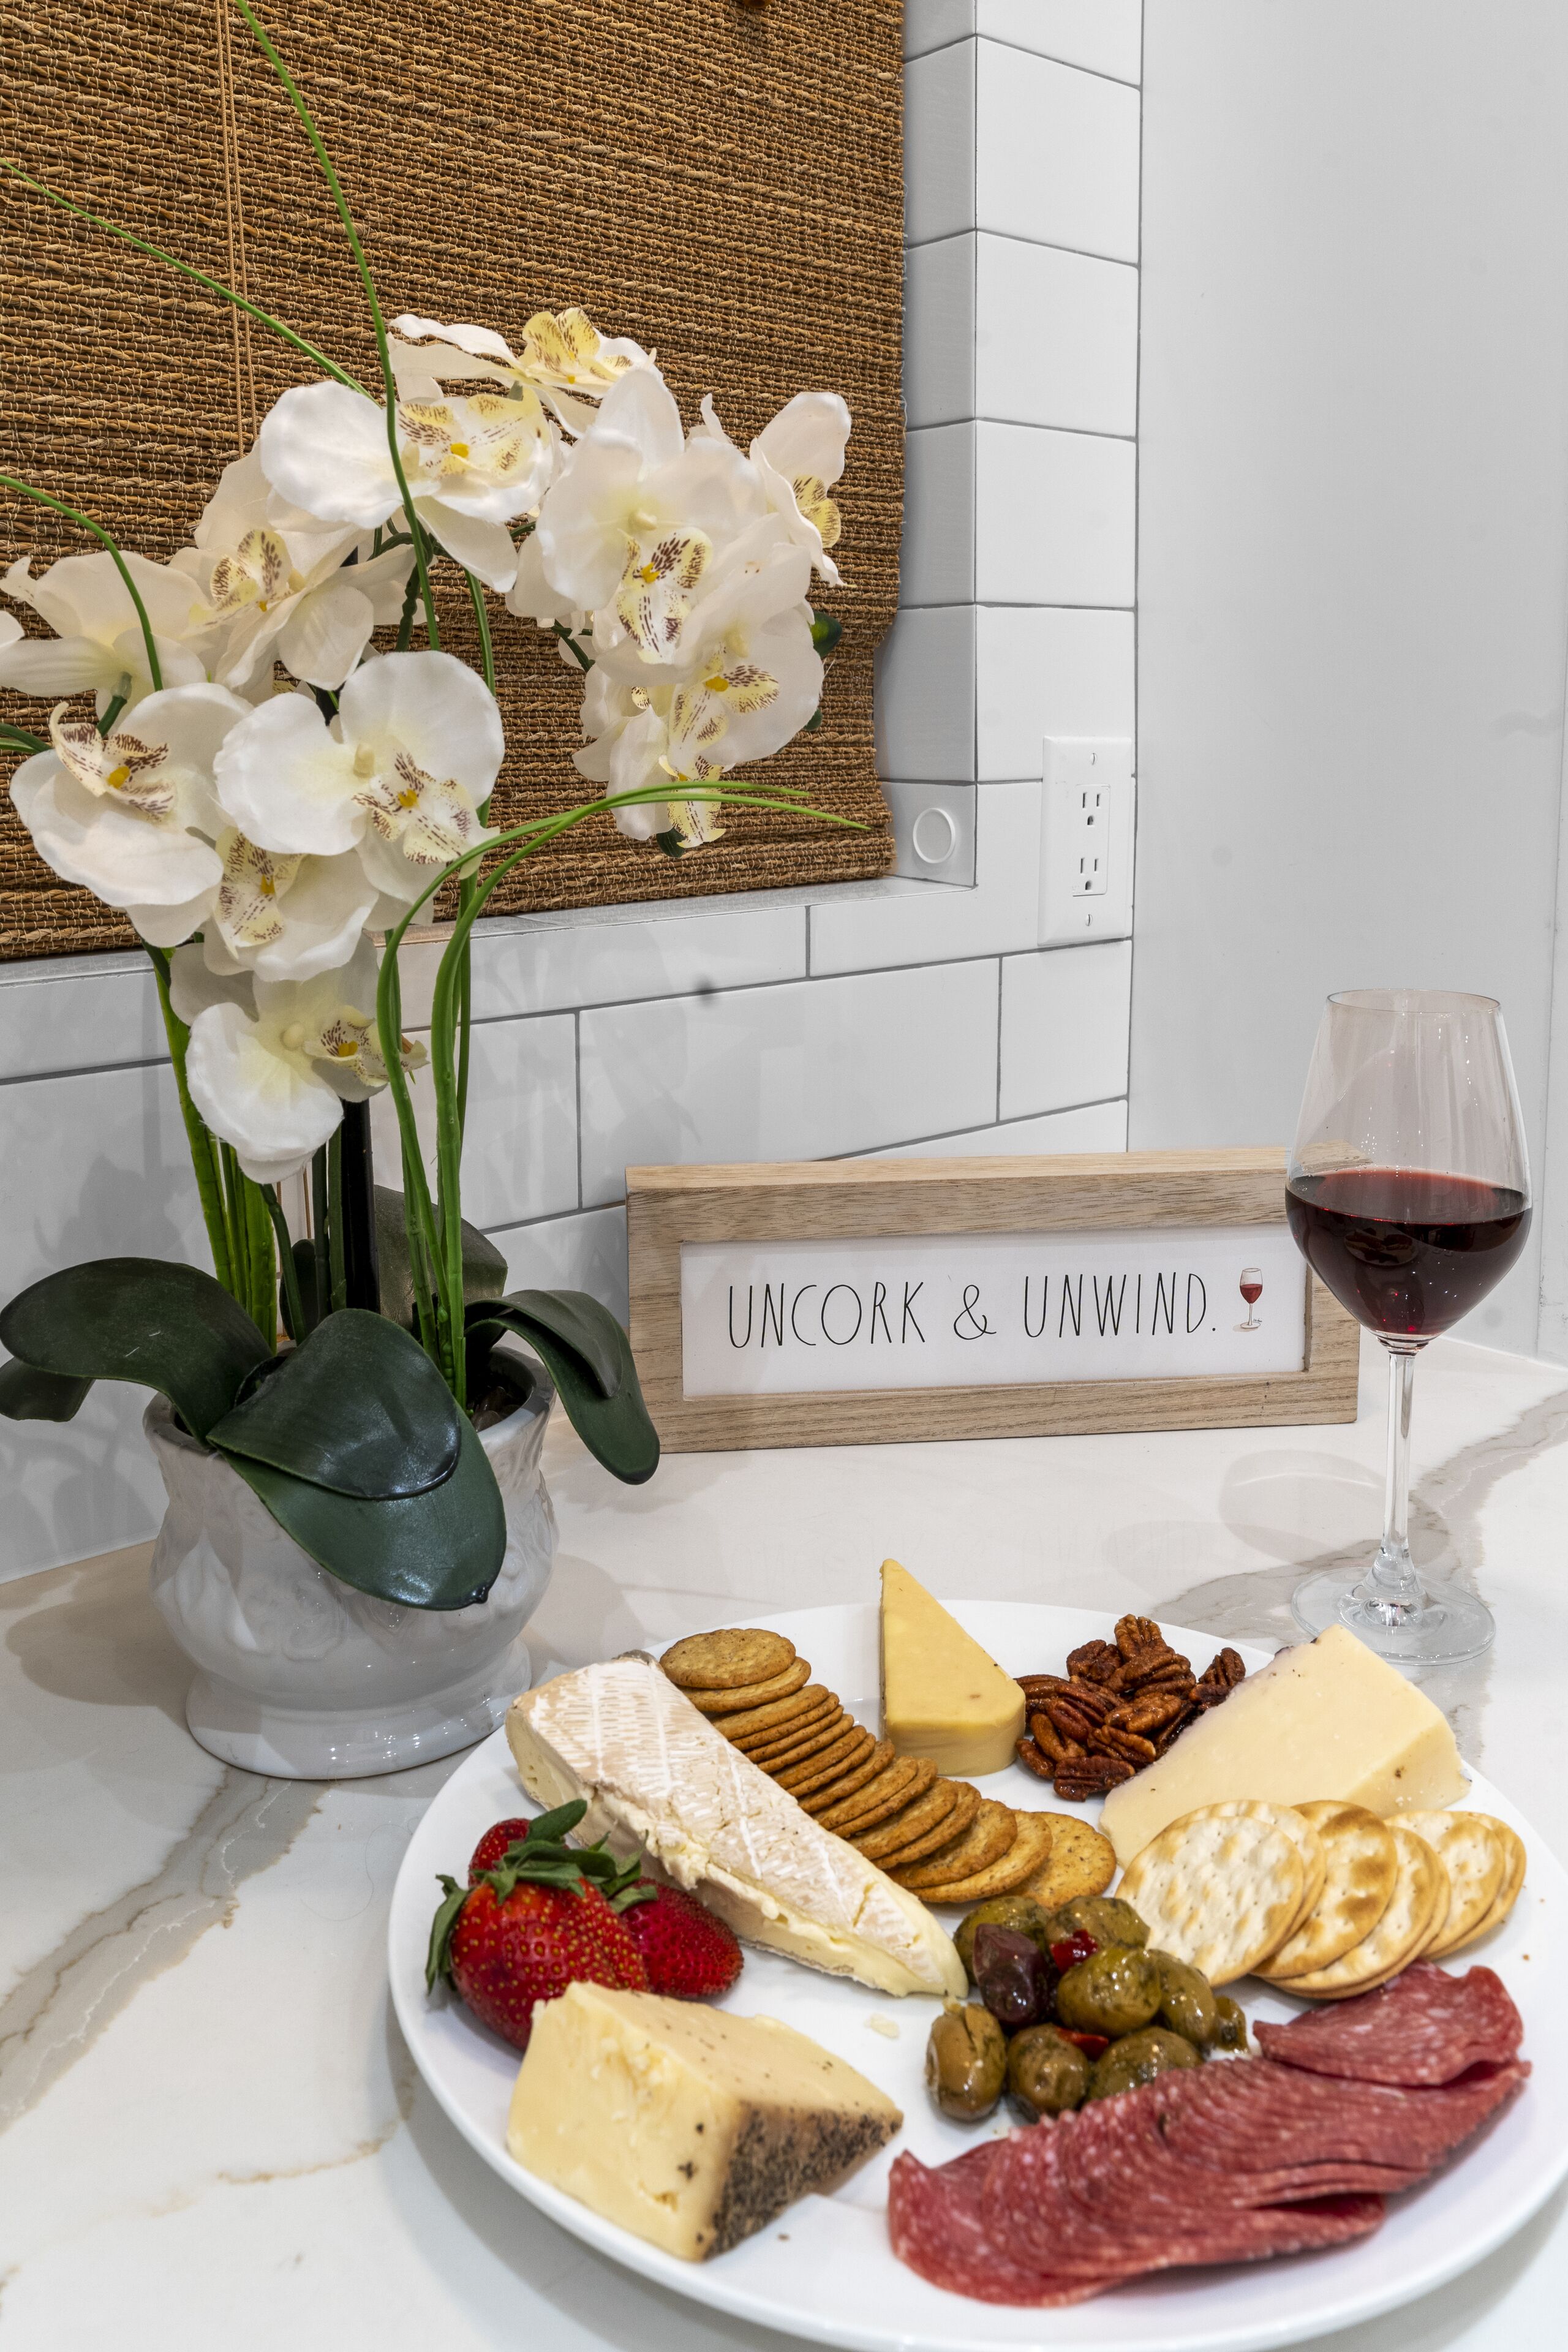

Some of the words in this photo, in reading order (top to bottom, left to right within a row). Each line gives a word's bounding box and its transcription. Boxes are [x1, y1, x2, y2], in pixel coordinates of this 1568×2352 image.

[728, 1281, 926, 1349] UNCORK
[952, 1283, 998, 1341] &
[1023, 1271, 1216, 1338] UNWIND.
